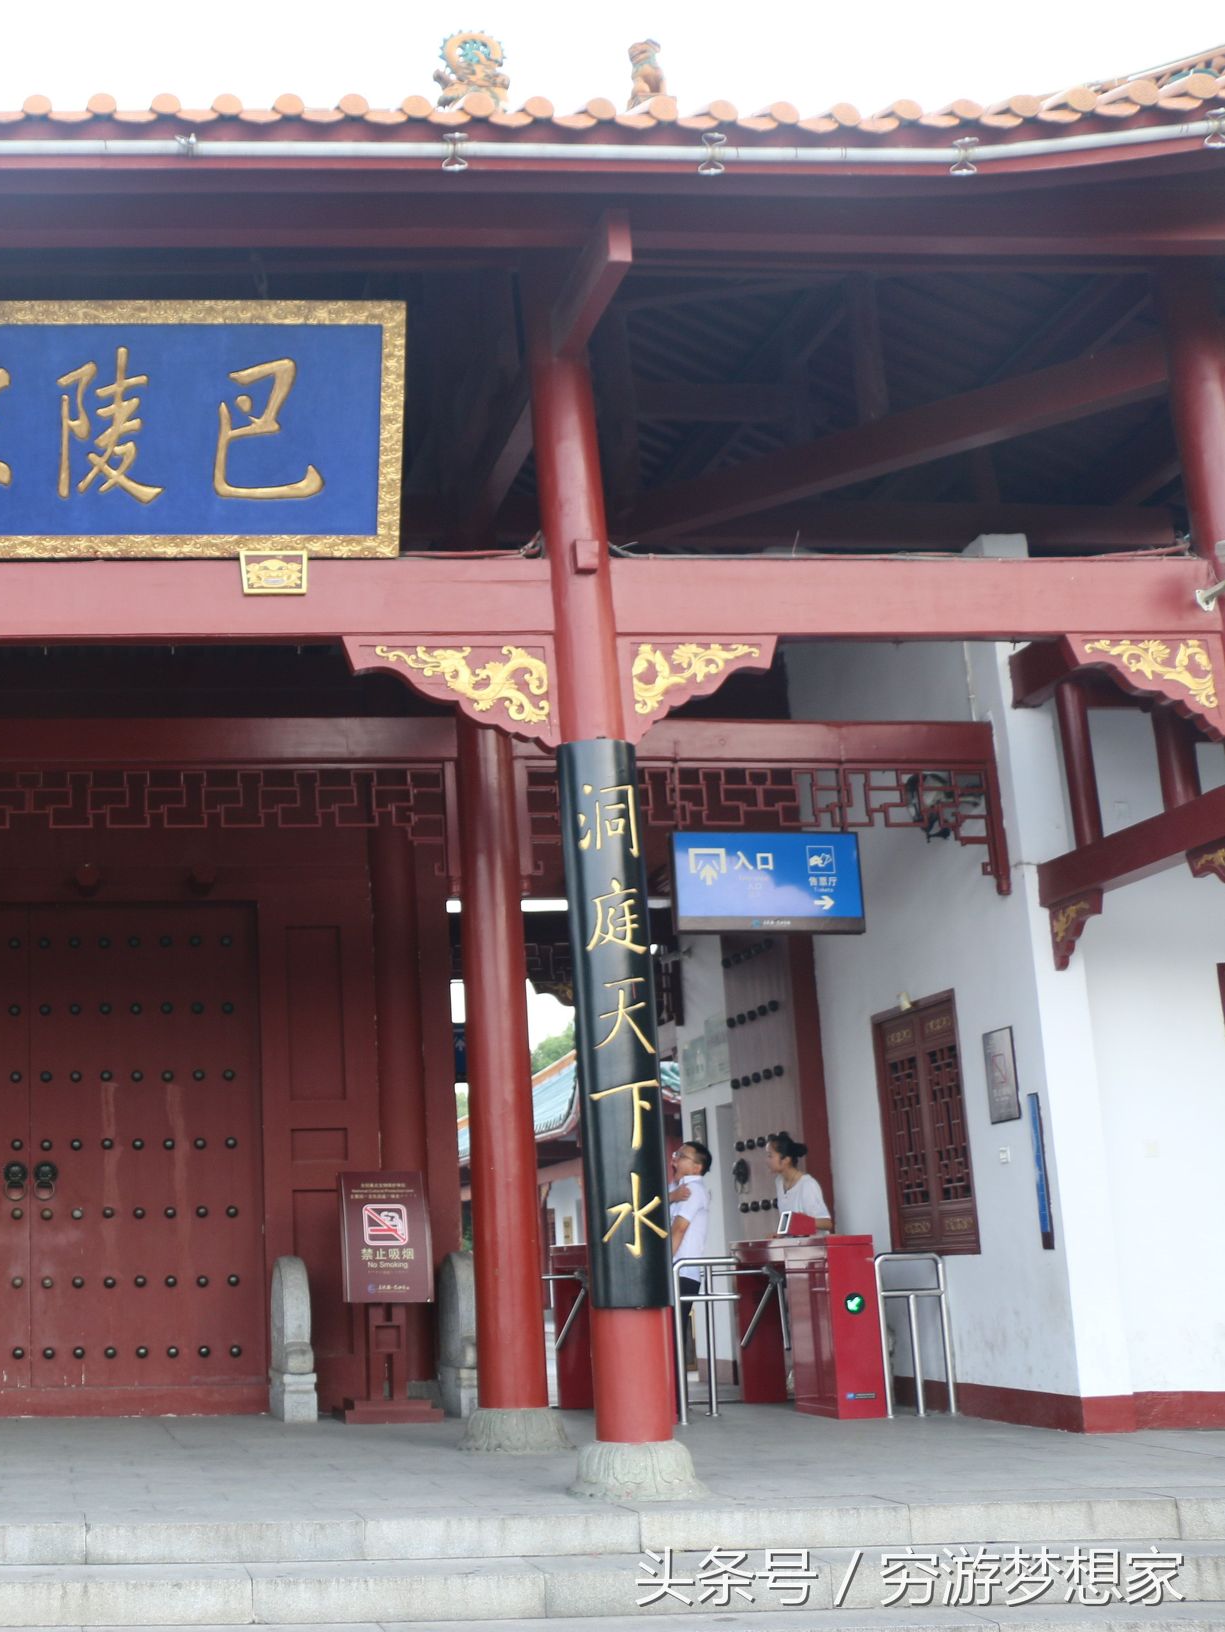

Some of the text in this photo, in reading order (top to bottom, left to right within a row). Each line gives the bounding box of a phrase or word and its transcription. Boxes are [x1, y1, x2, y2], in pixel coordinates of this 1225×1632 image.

[733, 851, 774, 870] 入口
[577, 783, 669, 1258] 洞庭天下水
[361, 1248, 414, 1260] 禁止吸烟
[379, 1261, 408, 1269] Smoking
